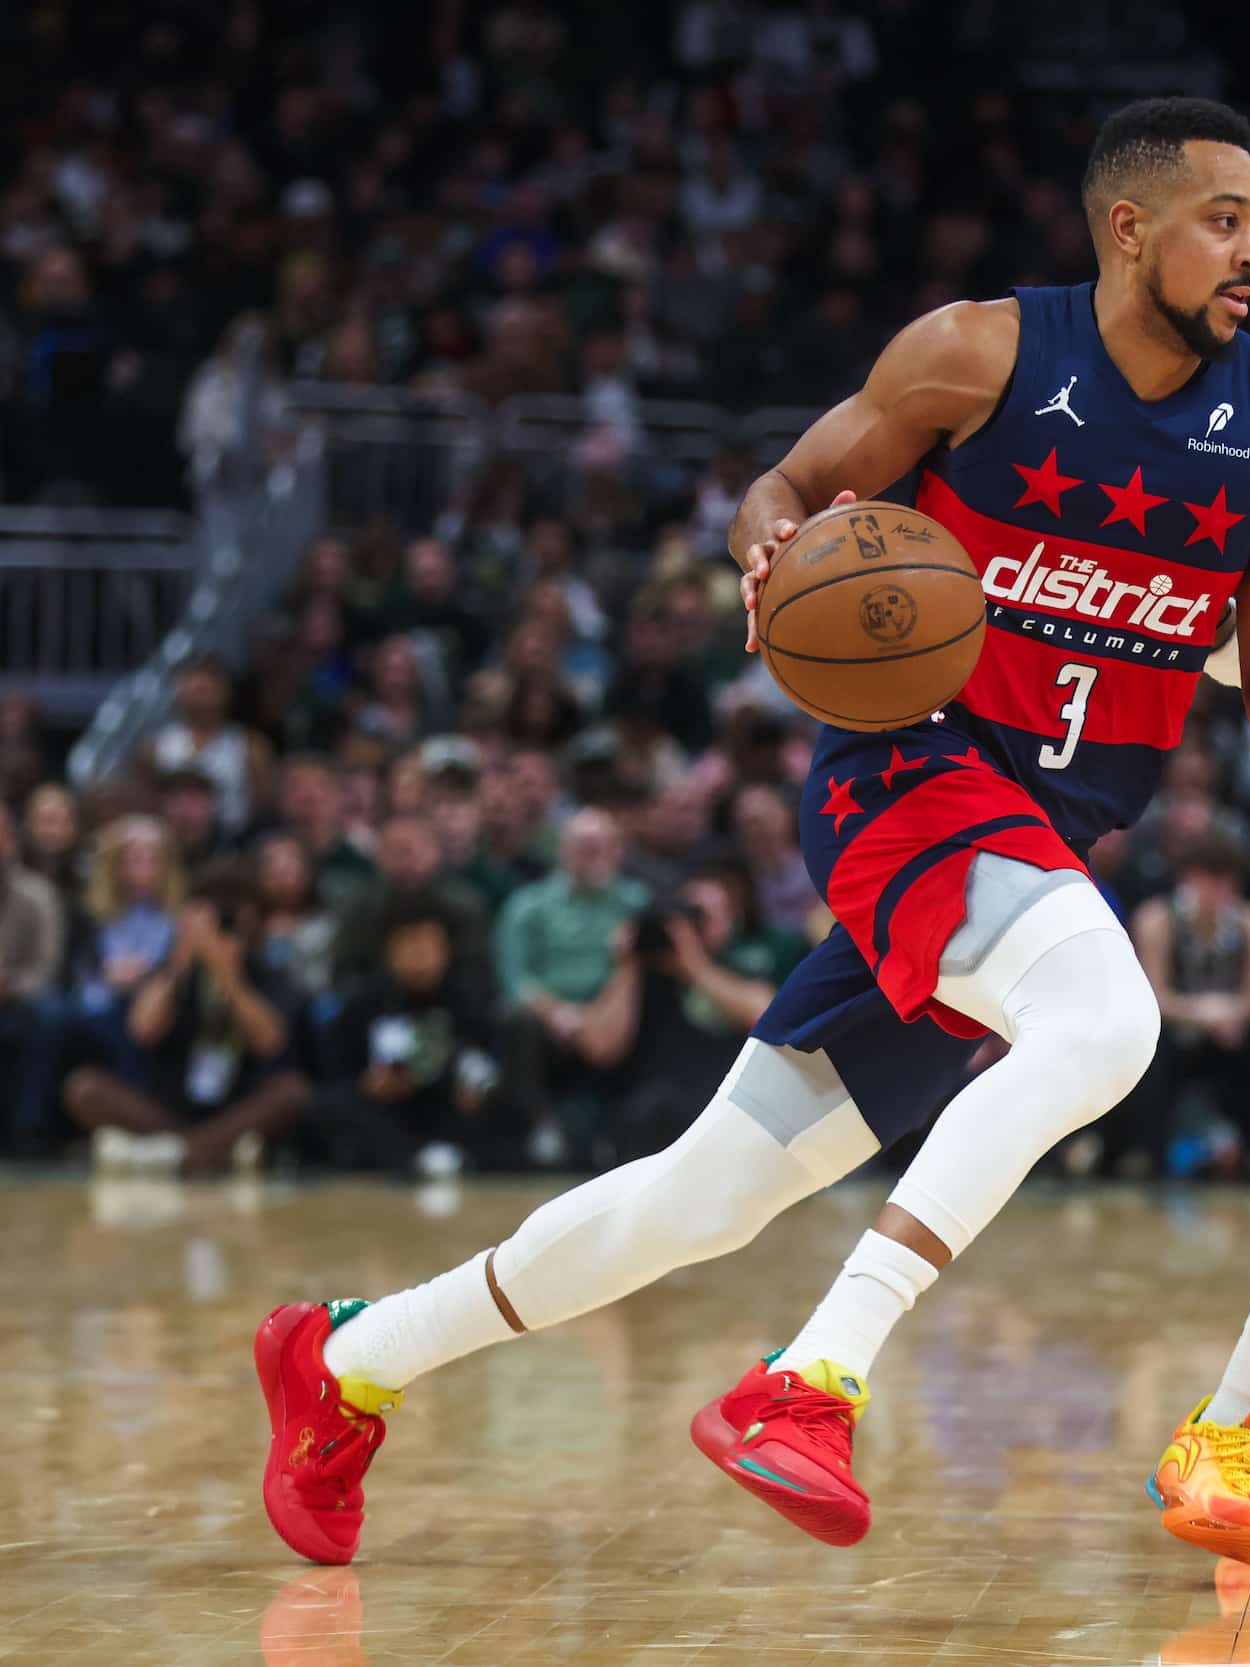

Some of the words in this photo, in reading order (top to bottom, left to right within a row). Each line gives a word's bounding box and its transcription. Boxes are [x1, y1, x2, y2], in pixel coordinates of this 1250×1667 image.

[1187, 437, 1250, 459] Robinhood
[1059, 554, 1099, 574] THE
[981, 541, 1211, 636] district
[1022, 619, 1180, 661] COLUMBIA
[1038, 662, 1098, 770] 3
